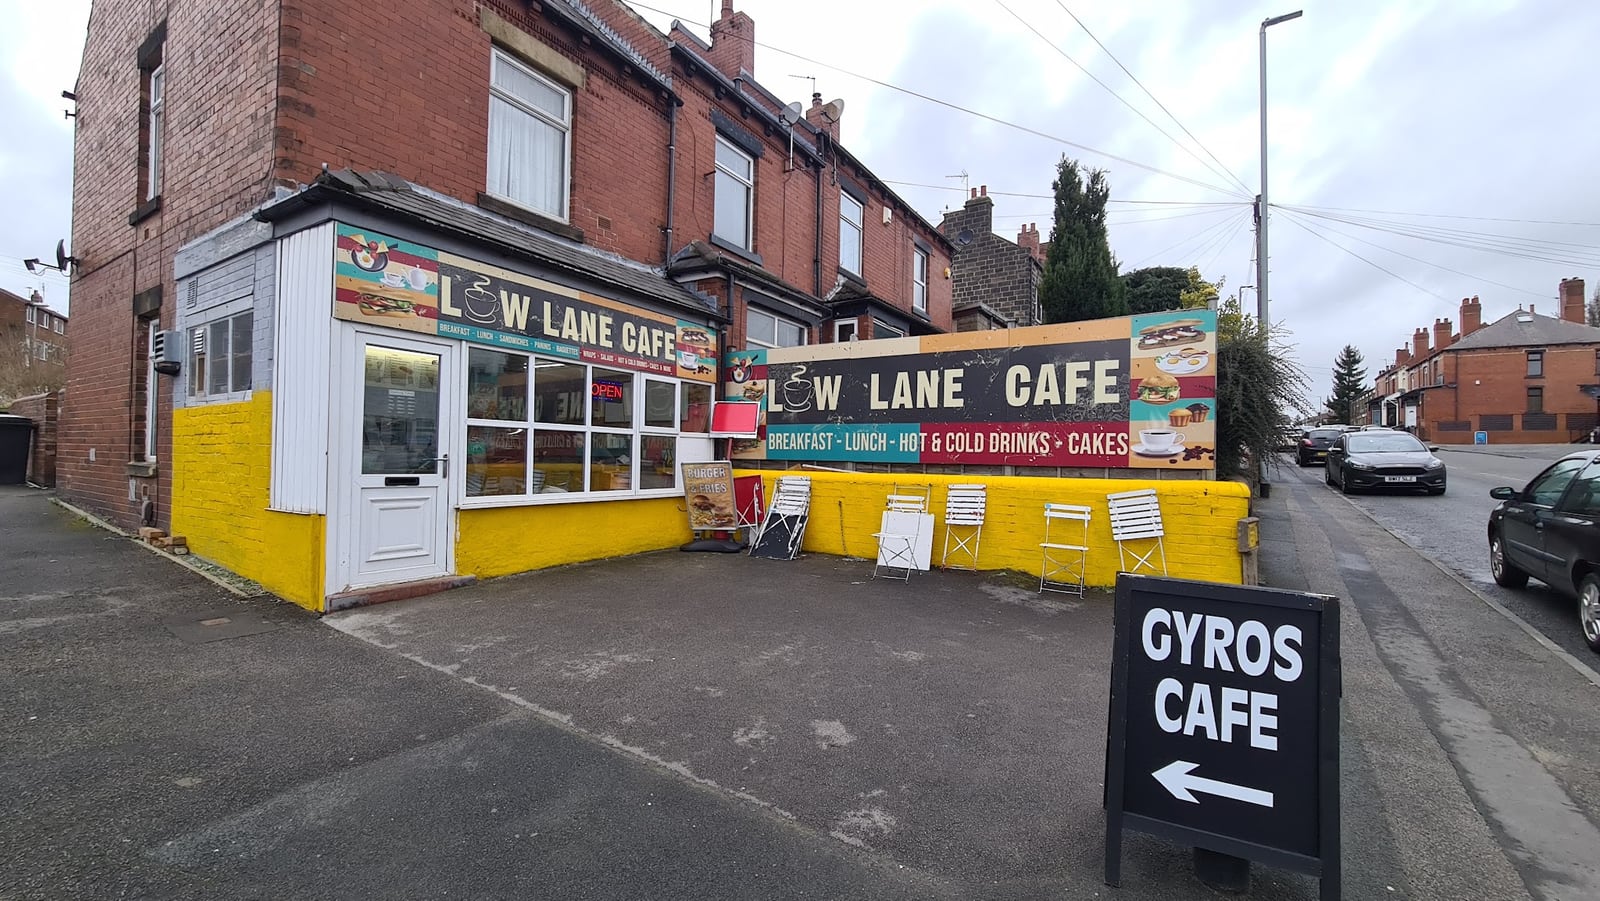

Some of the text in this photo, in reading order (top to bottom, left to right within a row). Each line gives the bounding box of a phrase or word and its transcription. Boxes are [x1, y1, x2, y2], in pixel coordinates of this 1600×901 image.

[440, 323, 470, 337] BREAKFAST
[477, 330, 493, 340] LUNCH
[499, 334, 529, 347] SANDWICHES
[583, 350, 597, 359] WRAPS
[543, 301, 613, 348] LANE
[622, 321, 676, 361] CAFE
[592, 383, 623, 399] OPEN
[870, 368, 964, 410] LANE
[1006, 359, 1120, 407] CAFE
[768, 432, 834, 451] BREAKFAST
[845, 432, 887, 452] LUNCH
[900, 432, 928, 453] HOT
[931, 433, 942, 453] &
[946, 432, 984, 453] COLD
[989, 432, 1050, 455] DRINKS
[1068, 432, 1129, 456] CAKES
[687, 467, 726, 478] BURGER
[691, 482, 727, 493] & FRIES
[1142, 607, 1304, 682] GYROS
[1154, 678, 1278, 751] CAFE
